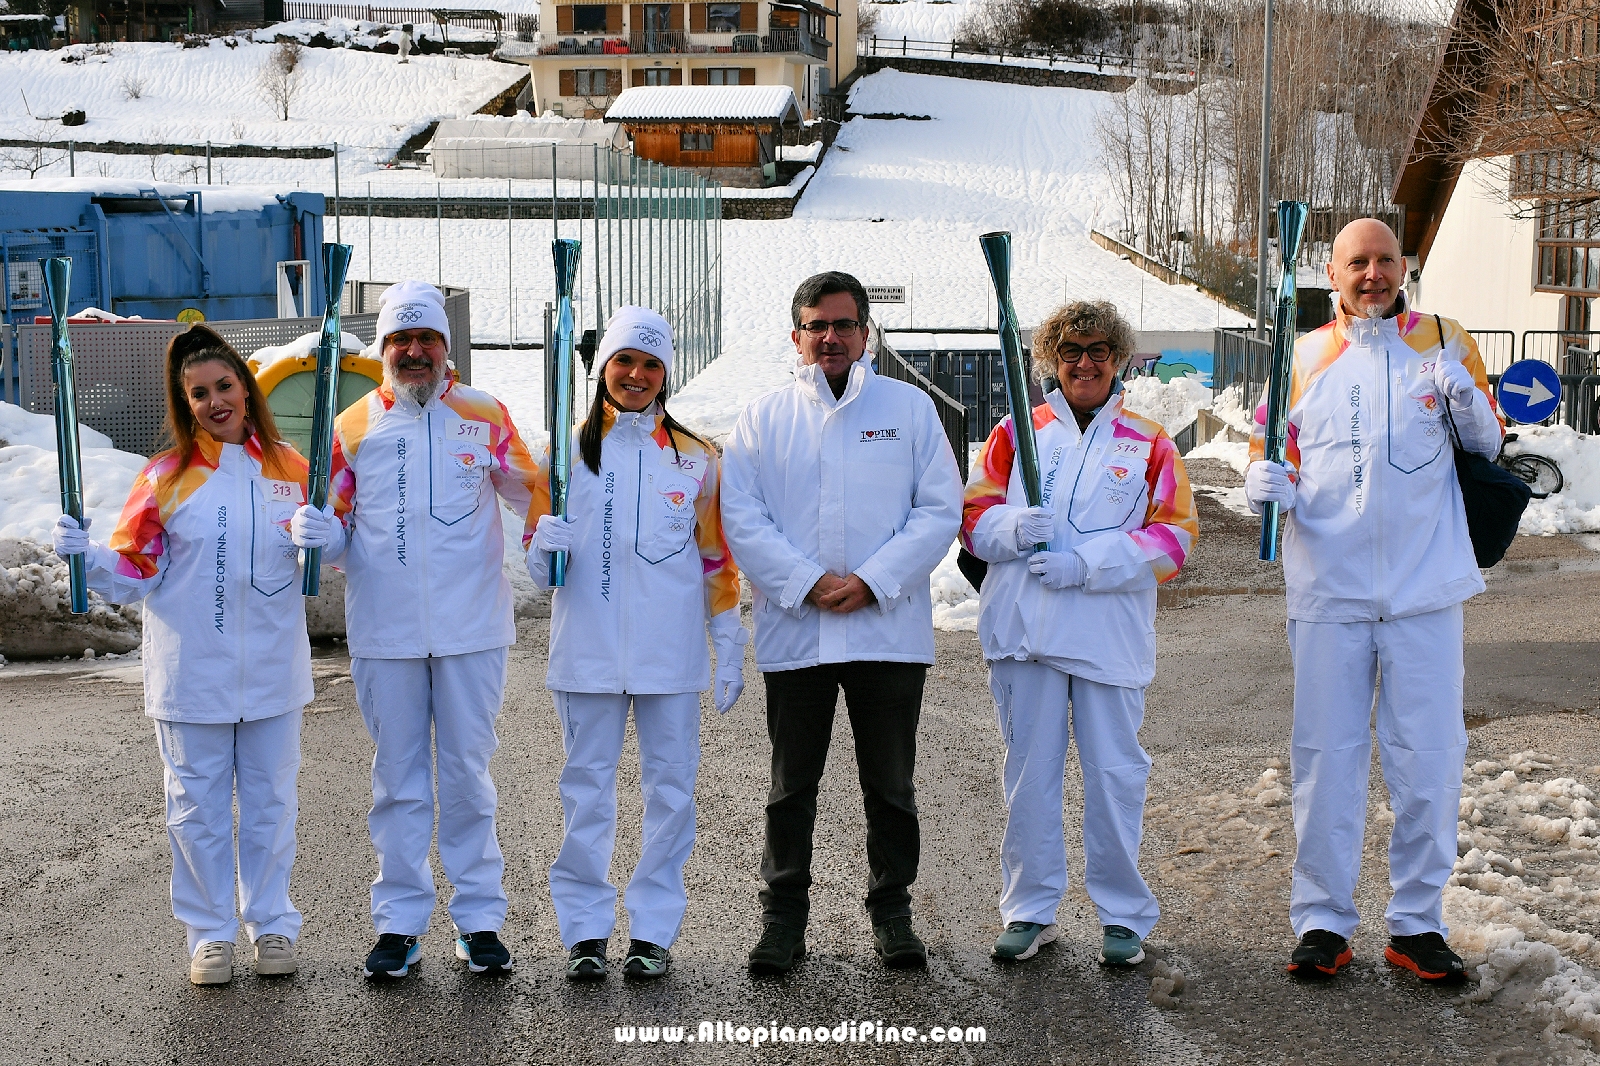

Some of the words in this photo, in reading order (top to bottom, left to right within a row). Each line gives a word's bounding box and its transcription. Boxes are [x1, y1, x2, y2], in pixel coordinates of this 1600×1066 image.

[1420, 361, 1436, 374] S1
[1350, 384, 1360, 408] 2026
[457, 423, 479, 437] S11
[860, 430, 866, 439] I
[1350, 410, 1361, 463] CORTINA
[397, 437, 406, 460] 2026
[1114, 442, 1139, 454] S14
[671, 455, 697, 470] S15
[272, 483, 291, 497] S13
[397, 463, 406, 514] CORTINA
[605, 471, 615, 494] 2026
[1042, 468, 1057, 505] ORTINA
[1354, 465, 1363, 518] MILANO
[217, 505, 227, 528] 2026
[602, 497, 613, 549] CORTINA
[396, 516, 406, 567] MILANO
[215, 531, 227, 583] CORTINA
[601, 550, 611, 602] MILANO
[214, 585, 225, 634] MILANO
